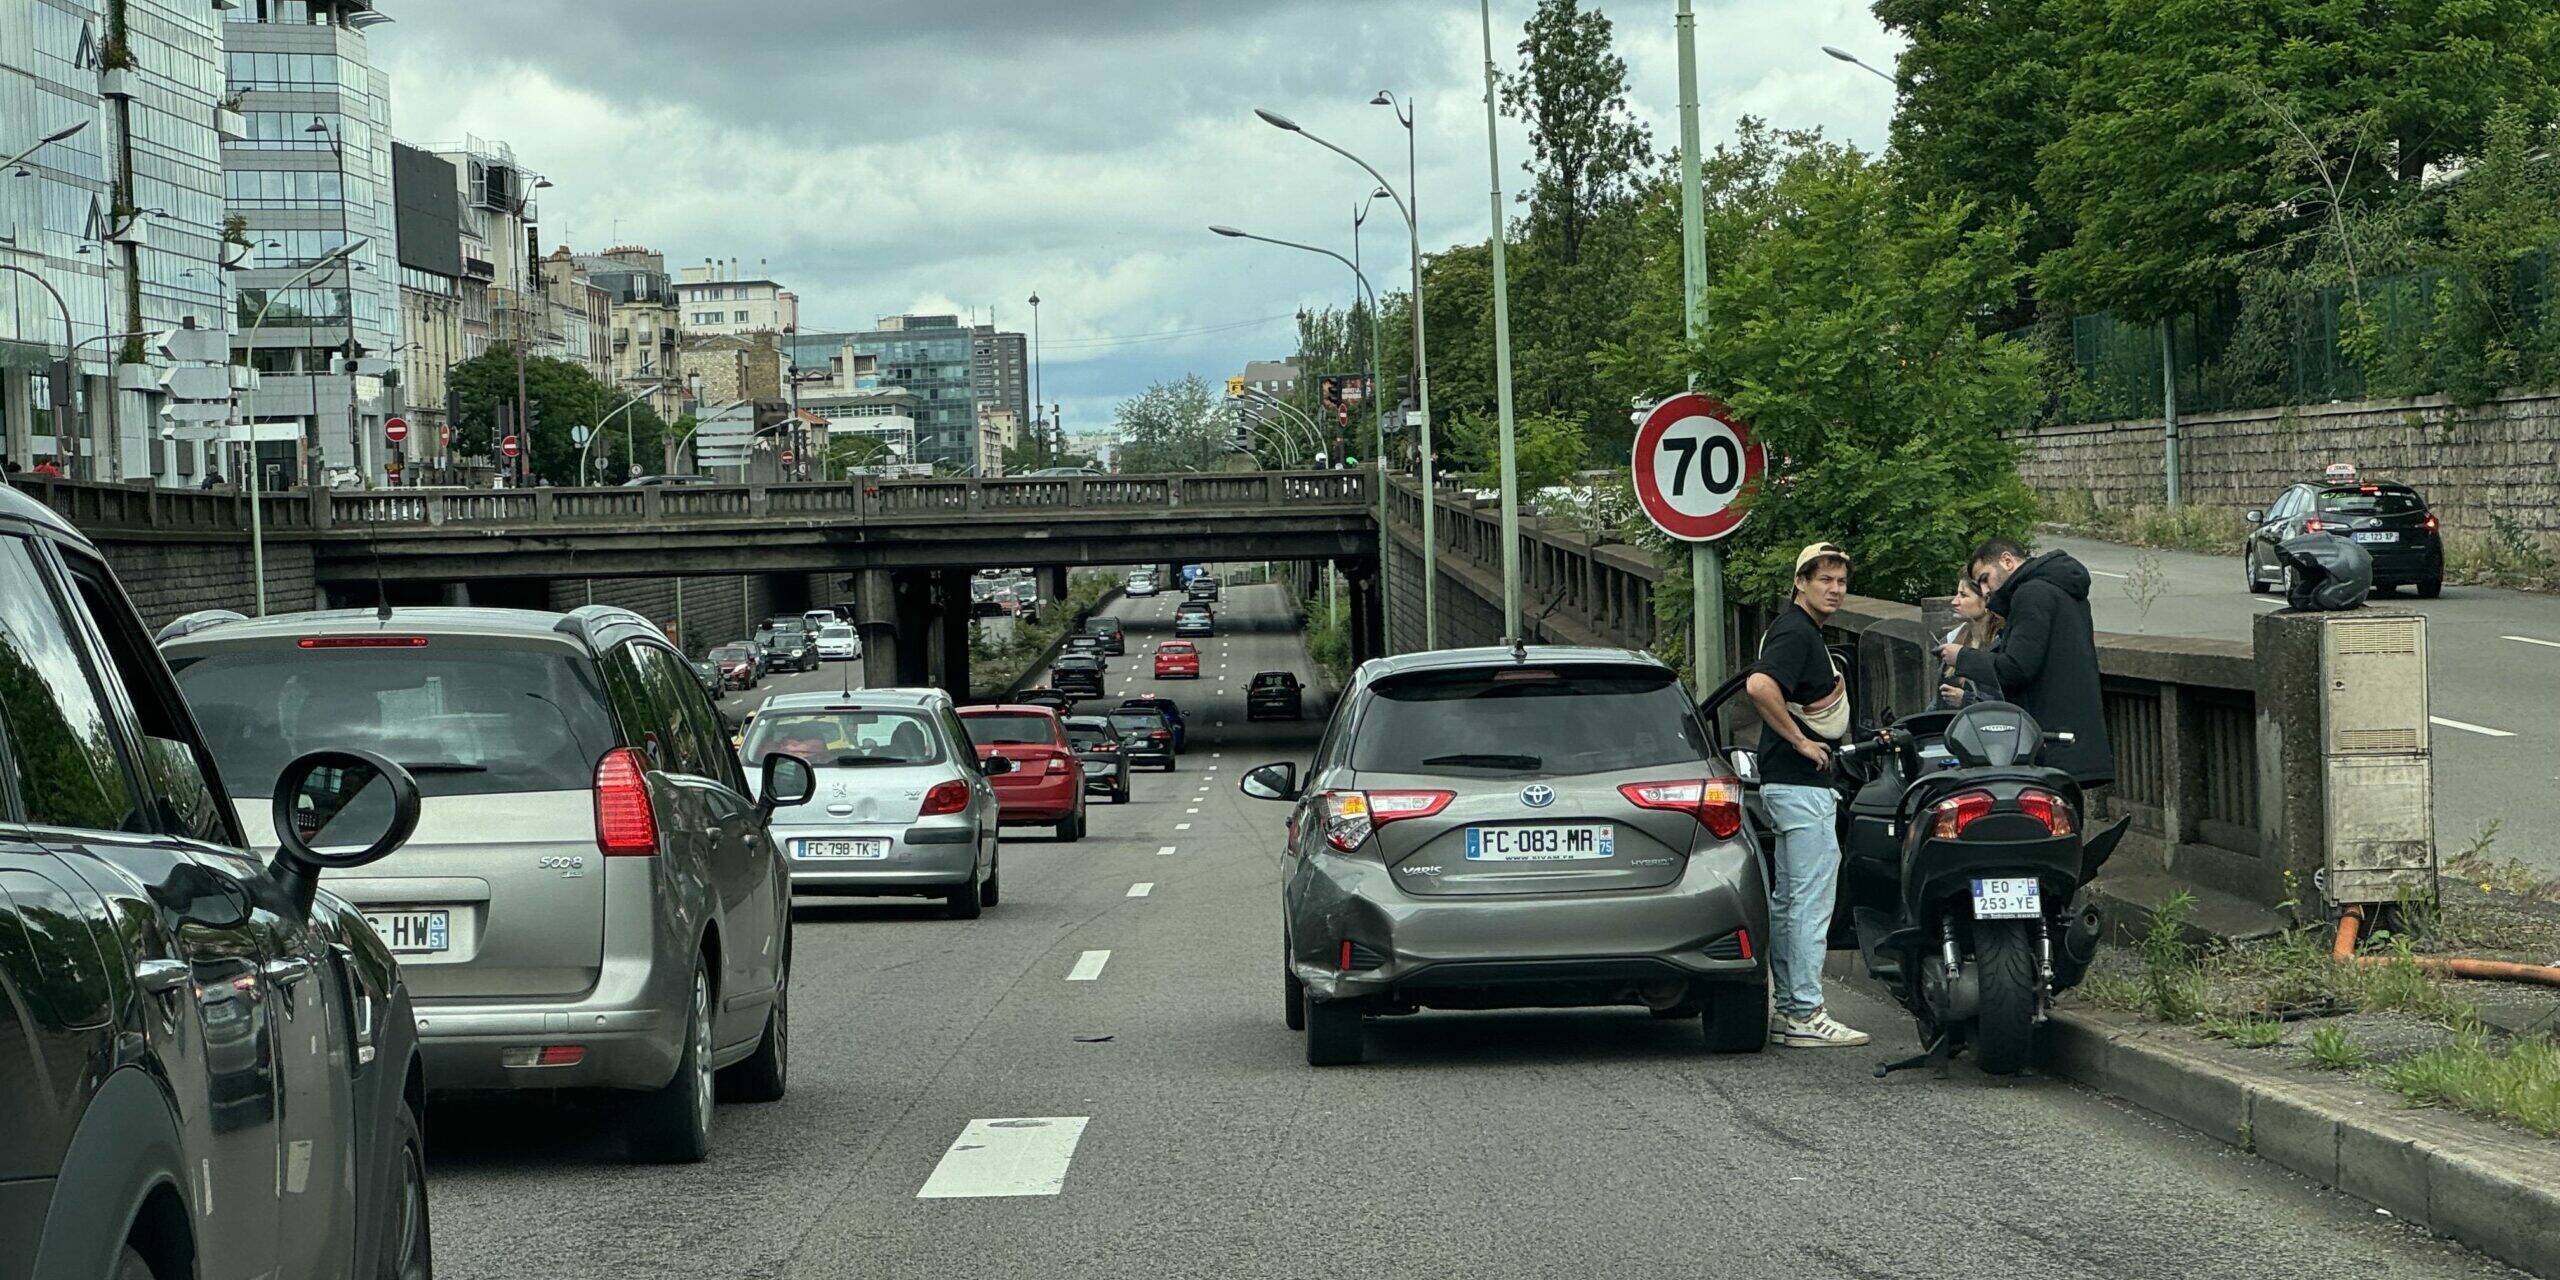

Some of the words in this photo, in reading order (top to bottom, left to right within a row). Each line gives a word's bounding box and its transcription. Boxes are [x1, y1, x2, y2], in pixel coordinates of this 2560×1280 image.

[1663, 435, 1739, 496] 70
[1483, 830, 1593, 853] FC-083-MR
[1601, 842, 1612, 852] 75
[539, 856, 584, 869] 5008
[1980, 897, 2034, 910] 253-YE
[431, 932, 446, 946] 51
